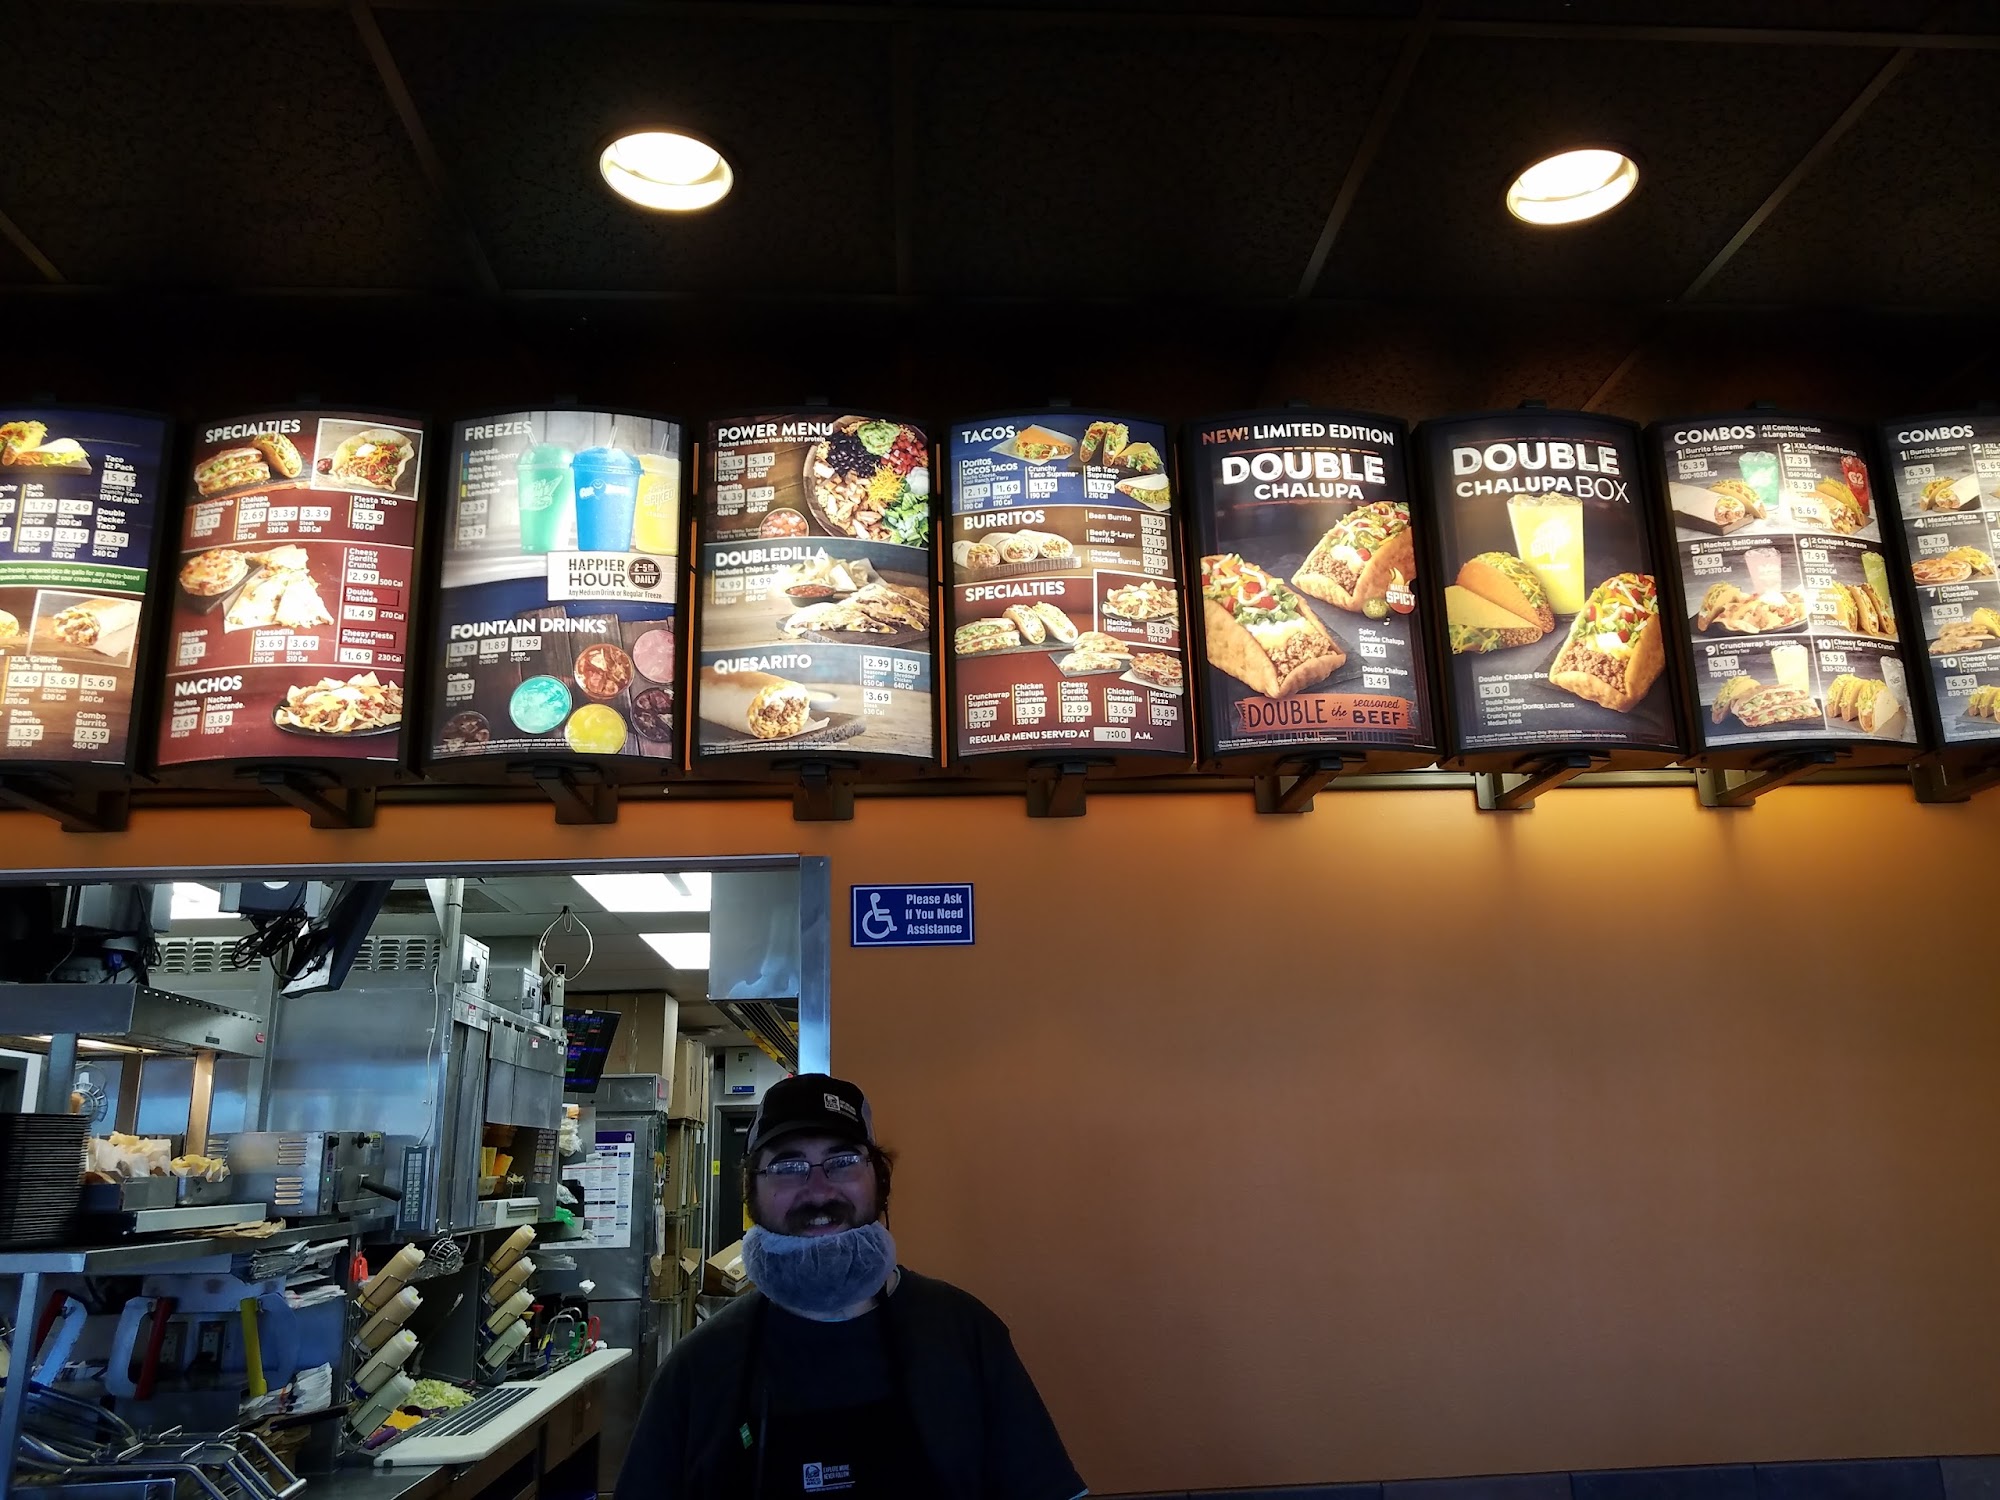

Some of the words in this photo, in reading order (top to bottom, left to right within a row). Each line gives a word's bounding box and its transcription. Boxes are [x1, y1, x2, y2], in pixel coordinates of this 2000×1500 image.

[205, 420, 300, 443] SPECIALTIES
[465, 421, 532, 442] FREEZES
[719, 423, 777, 441] POWER
[782, 423, 833, 436] MENU
[962, 426, 1015, 443] TACOS
[1202, 427, 1249, 445] NEW!
[1254, 424, 1325, 440] LIMITED
[1329, 425, 1394, 446] EDITION
[1674, 426, 1756, 444] COMBOS
[1898, 425, 1974, 444] COMBOS
[1686, 446, 1711, 454] Burrito
[106, 455, 124, 463] Taco
[1452, 442, 1619, 475] DOUBLE
[992, 463, 1018, 472] TACOS
[1222, 452, 1386, 485] DOUBLE
[1848, 472, 1864, 484] G2
[1254, 483, 1364, 500] CHALUPA
[1456, 476, 1573, 498] CHALUPA
[1576, 475, 1630, 503] BOX
[98, 508, 125, 516] Double
[1108, 513, 1132, 521] Burrito
[964, 510, 1045, 531] BURRITOS
[1914, 519, 1924, 528] 4
[1928, 515, 1956, 523] Mexican
[349, 548, 378, 557] Cheesy
[716, 547, 828, 567] DOUBLEDILLA
[349, 555, 378, 563] Gordita
[569, 559, 624, 571] HAPPIER
[635, 576, 656, 584] DAILY
[623, 590, 643, 598] Regular
[645, 591, 662, 599] Freeze
[965, 581, 1065, 601] SPECIALTIES
[1927, 588, 1936, 598] 7
[347, 595, 378, 603] Tostada
[1386, 591, 1415, 606] SPICY
[343, 629, 370, 638] Cheesy
[371, 630, 393, 639] Fiesta
[451, 618, 536, 640] FOUNTAIN
[540, 618, 606, 634] DRINKS
[1359, 628, 1376, 636] Spicy
[342, 636, 375, 645] Potatoes
[1360, 635, 1380, 643] Double
[1382, 637, 1404, 645] Chalupa
[1817, 639, 1830, 649] 10
[714, 655, 812, 674] QUESARITO
[1940, 659, 1957, 668] 10
[1961, 655, 1986, 663] Cheesy
[448, 673, 469, 681] Coffee
[1385, 667, 1407, 676] Chalupa
[175, 676, 242, 696] NACHOS
[968, 691, 1010, 700] Crunchwrap
[1150, 691, 1176, 699] Mexican
[1353, 700, 1400, 709] seasoned
[1249, 700, 1327, 727] DOUBLE
[1331, 706, 1347, 717] the
[970, 733, 1010, 744] REGULAR
[1012, 732, 1039, 740] MENU
[1041, 730, 1077, 739] SERVED
[1106, 731, 1126, 739] 7:00
[1135, 732, 1153, 740] A.M.
[907, 894, 940, 905] Please
[944, 893, 962, 904] Ask
[906, 909, 913, 919] If
[915, 909, 934, 919] You
[937, 908, 963, 919] Need
[907, 924, 962, 935] Assistance
